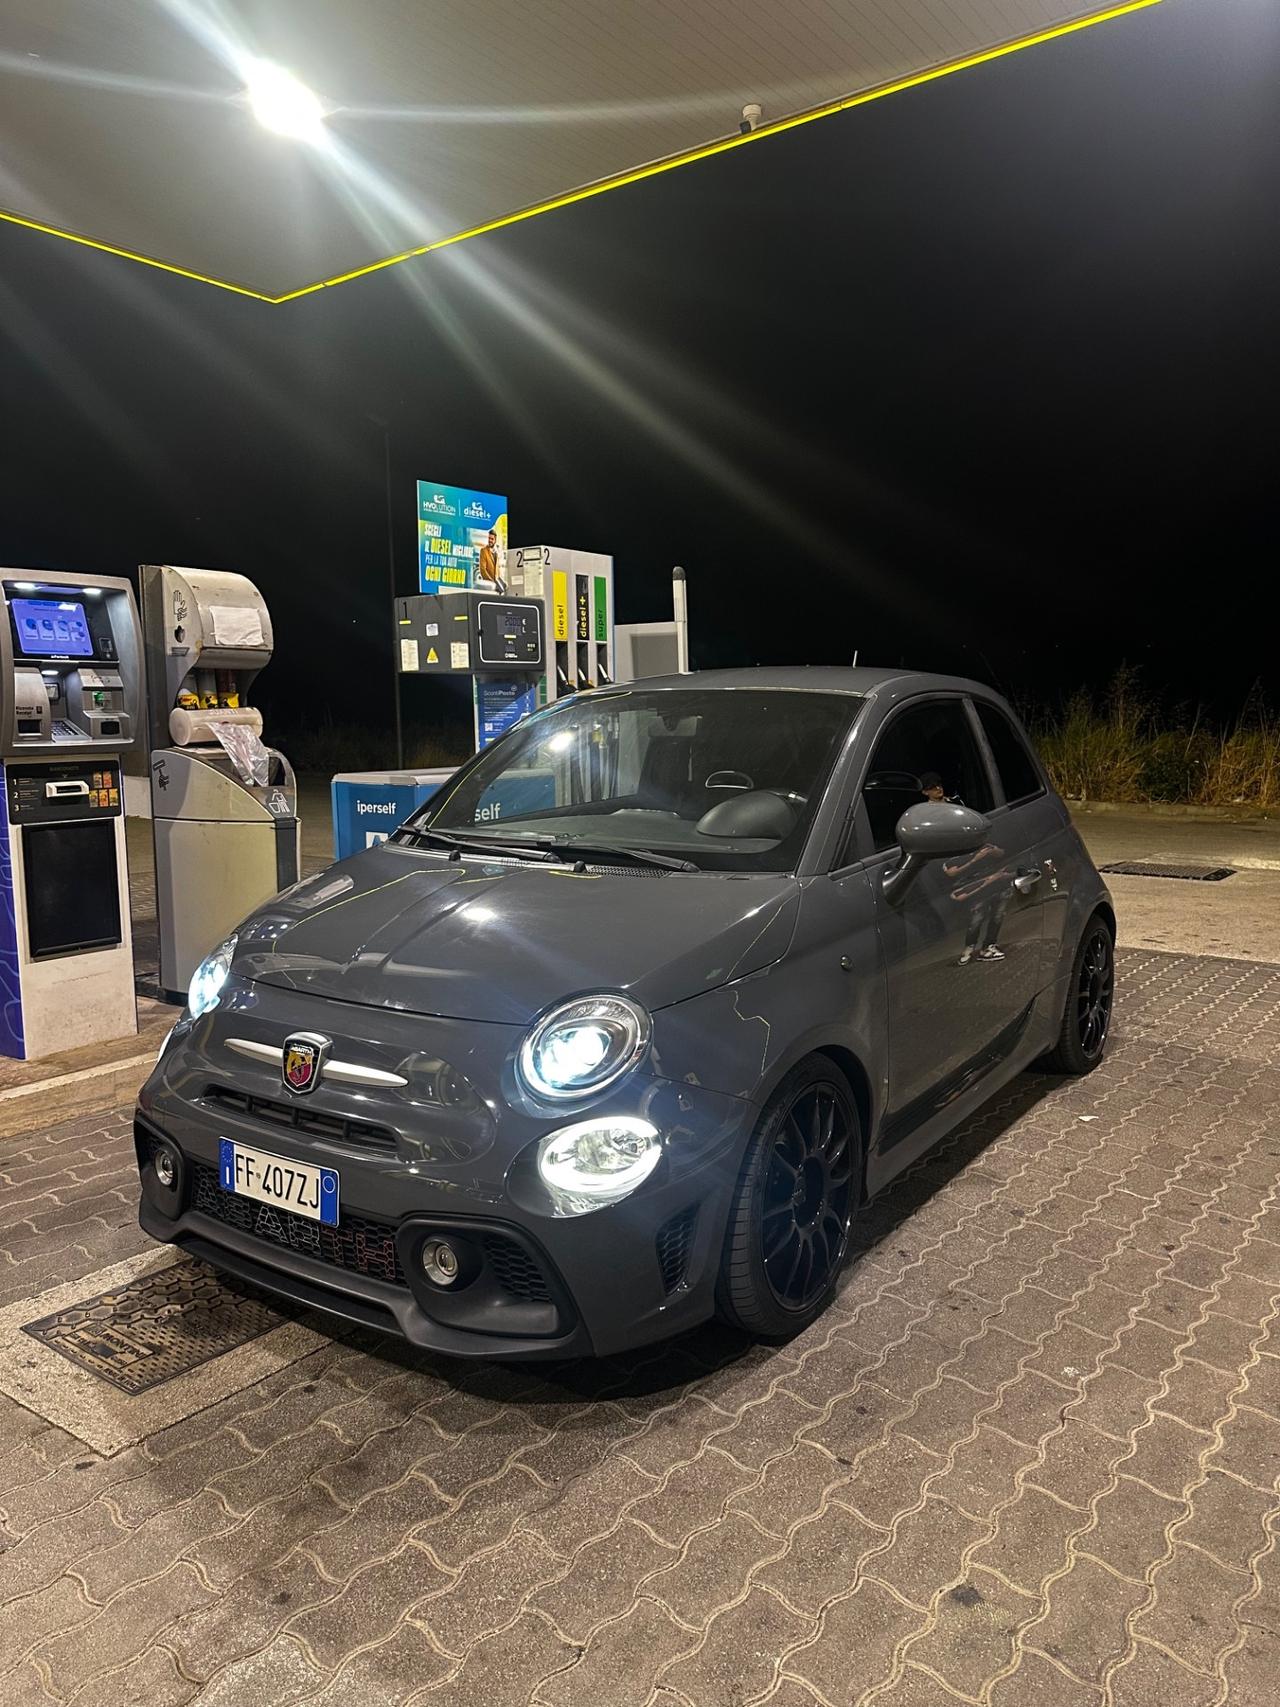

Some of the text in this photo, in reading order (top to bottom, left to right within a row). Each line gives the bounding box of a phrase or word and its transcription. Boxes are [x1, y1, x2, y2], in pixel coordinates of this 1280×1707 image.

[431, 538, 451, 555] DIESEL
[425, 553, 433, 564] PER
[516, 551, 523, 568] 2
[544, 548, 551, 566] 2
[425, 565, 466, 584] OGNI GIORNO
[356, 800, 396, 815] iperself
